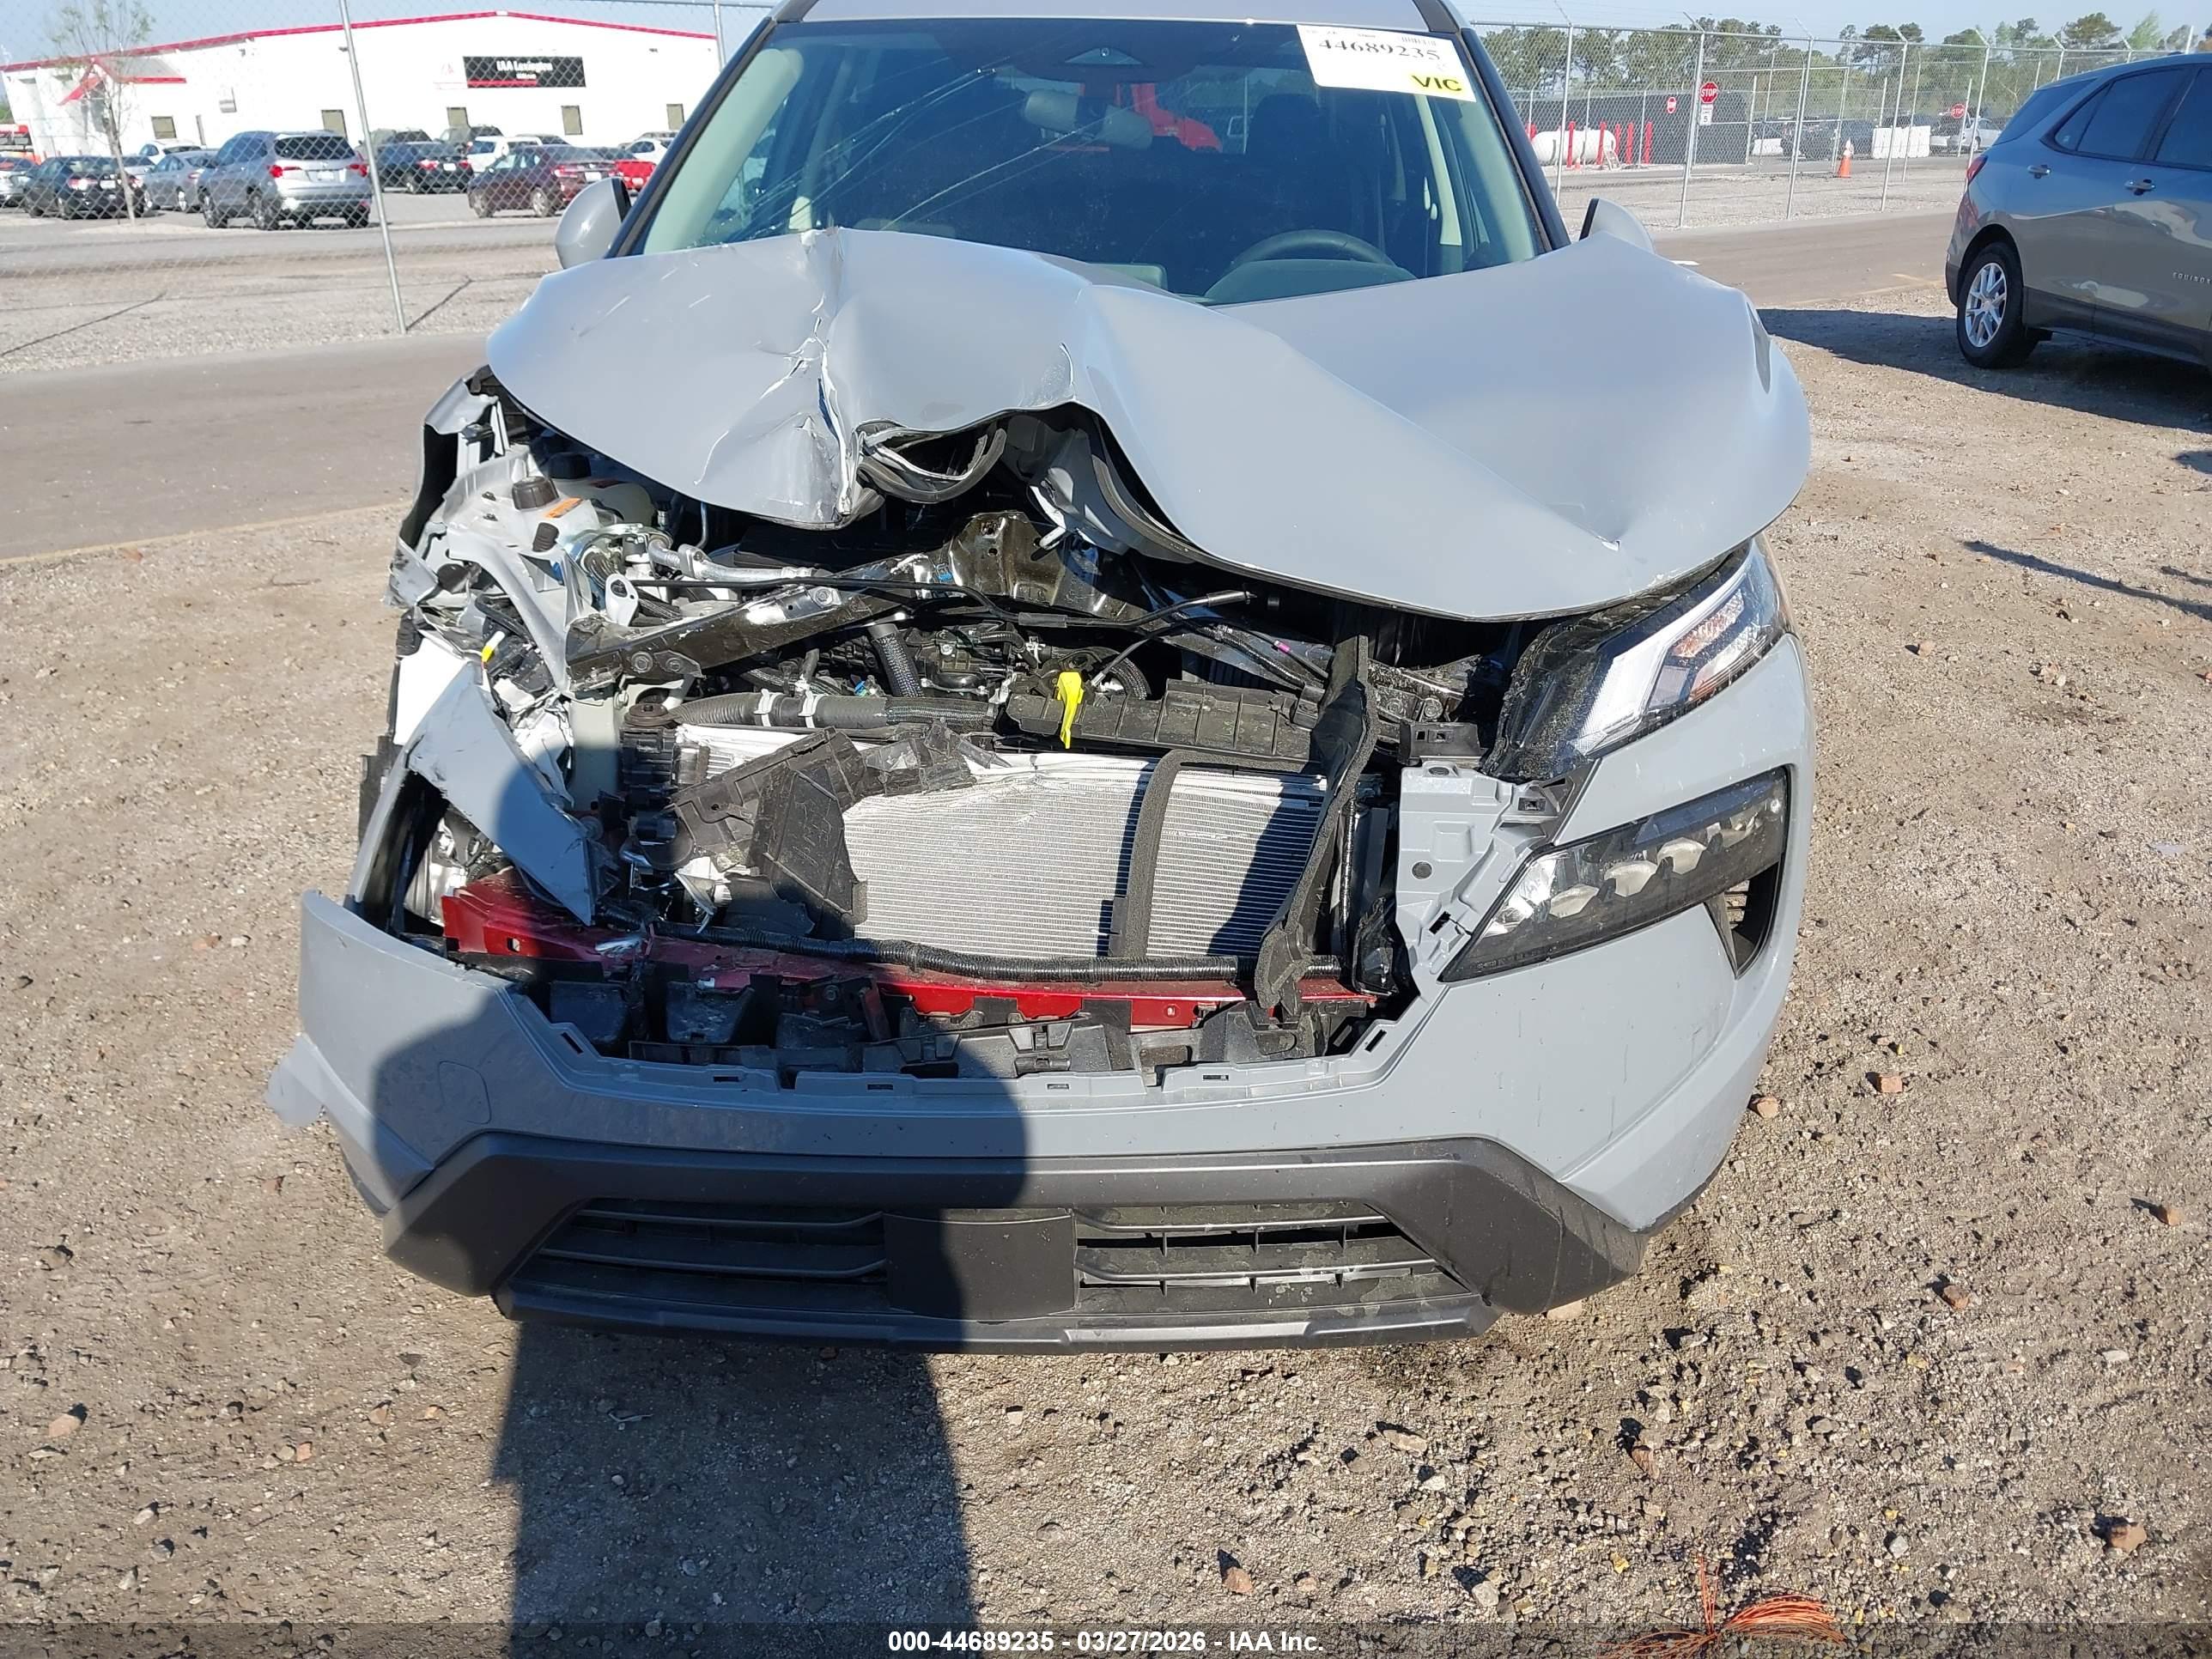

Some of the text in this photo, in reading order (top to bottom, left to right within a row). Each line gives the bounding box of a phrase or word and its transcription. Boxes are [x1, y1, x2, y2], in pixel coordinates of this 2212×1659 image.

[1319, 40, 1441, 61] 44689235
[1412, 75, 1462, 92] VIC
[1701, 88, 1717, 97] STOP
